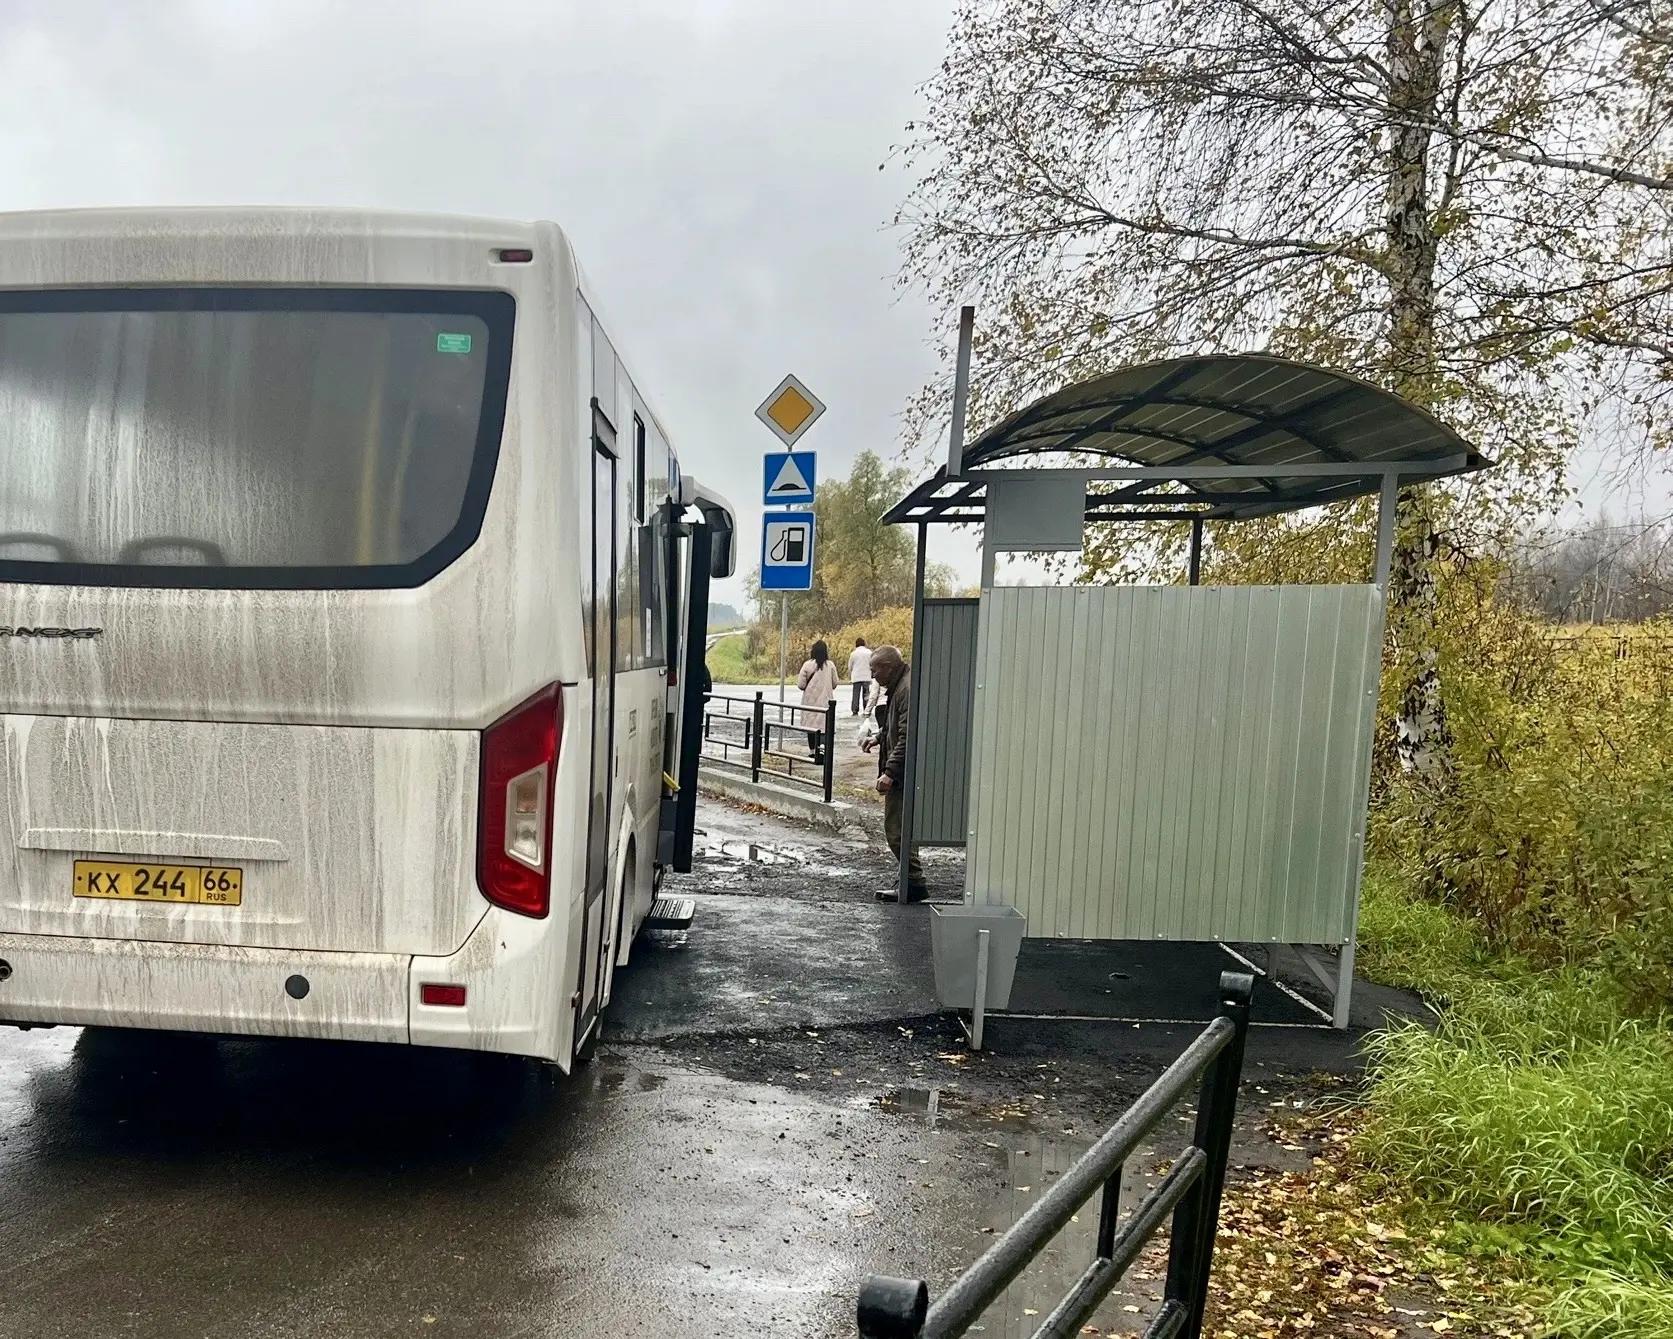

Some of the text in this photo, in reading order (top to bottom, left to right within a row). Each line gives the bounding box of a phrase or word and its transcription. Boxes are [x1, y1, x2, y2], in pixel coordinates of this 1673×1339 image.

[133, 868, 186, 898] 244
[203, 870, 231, 892] 66
[206, 893, 227, 901] RUS
